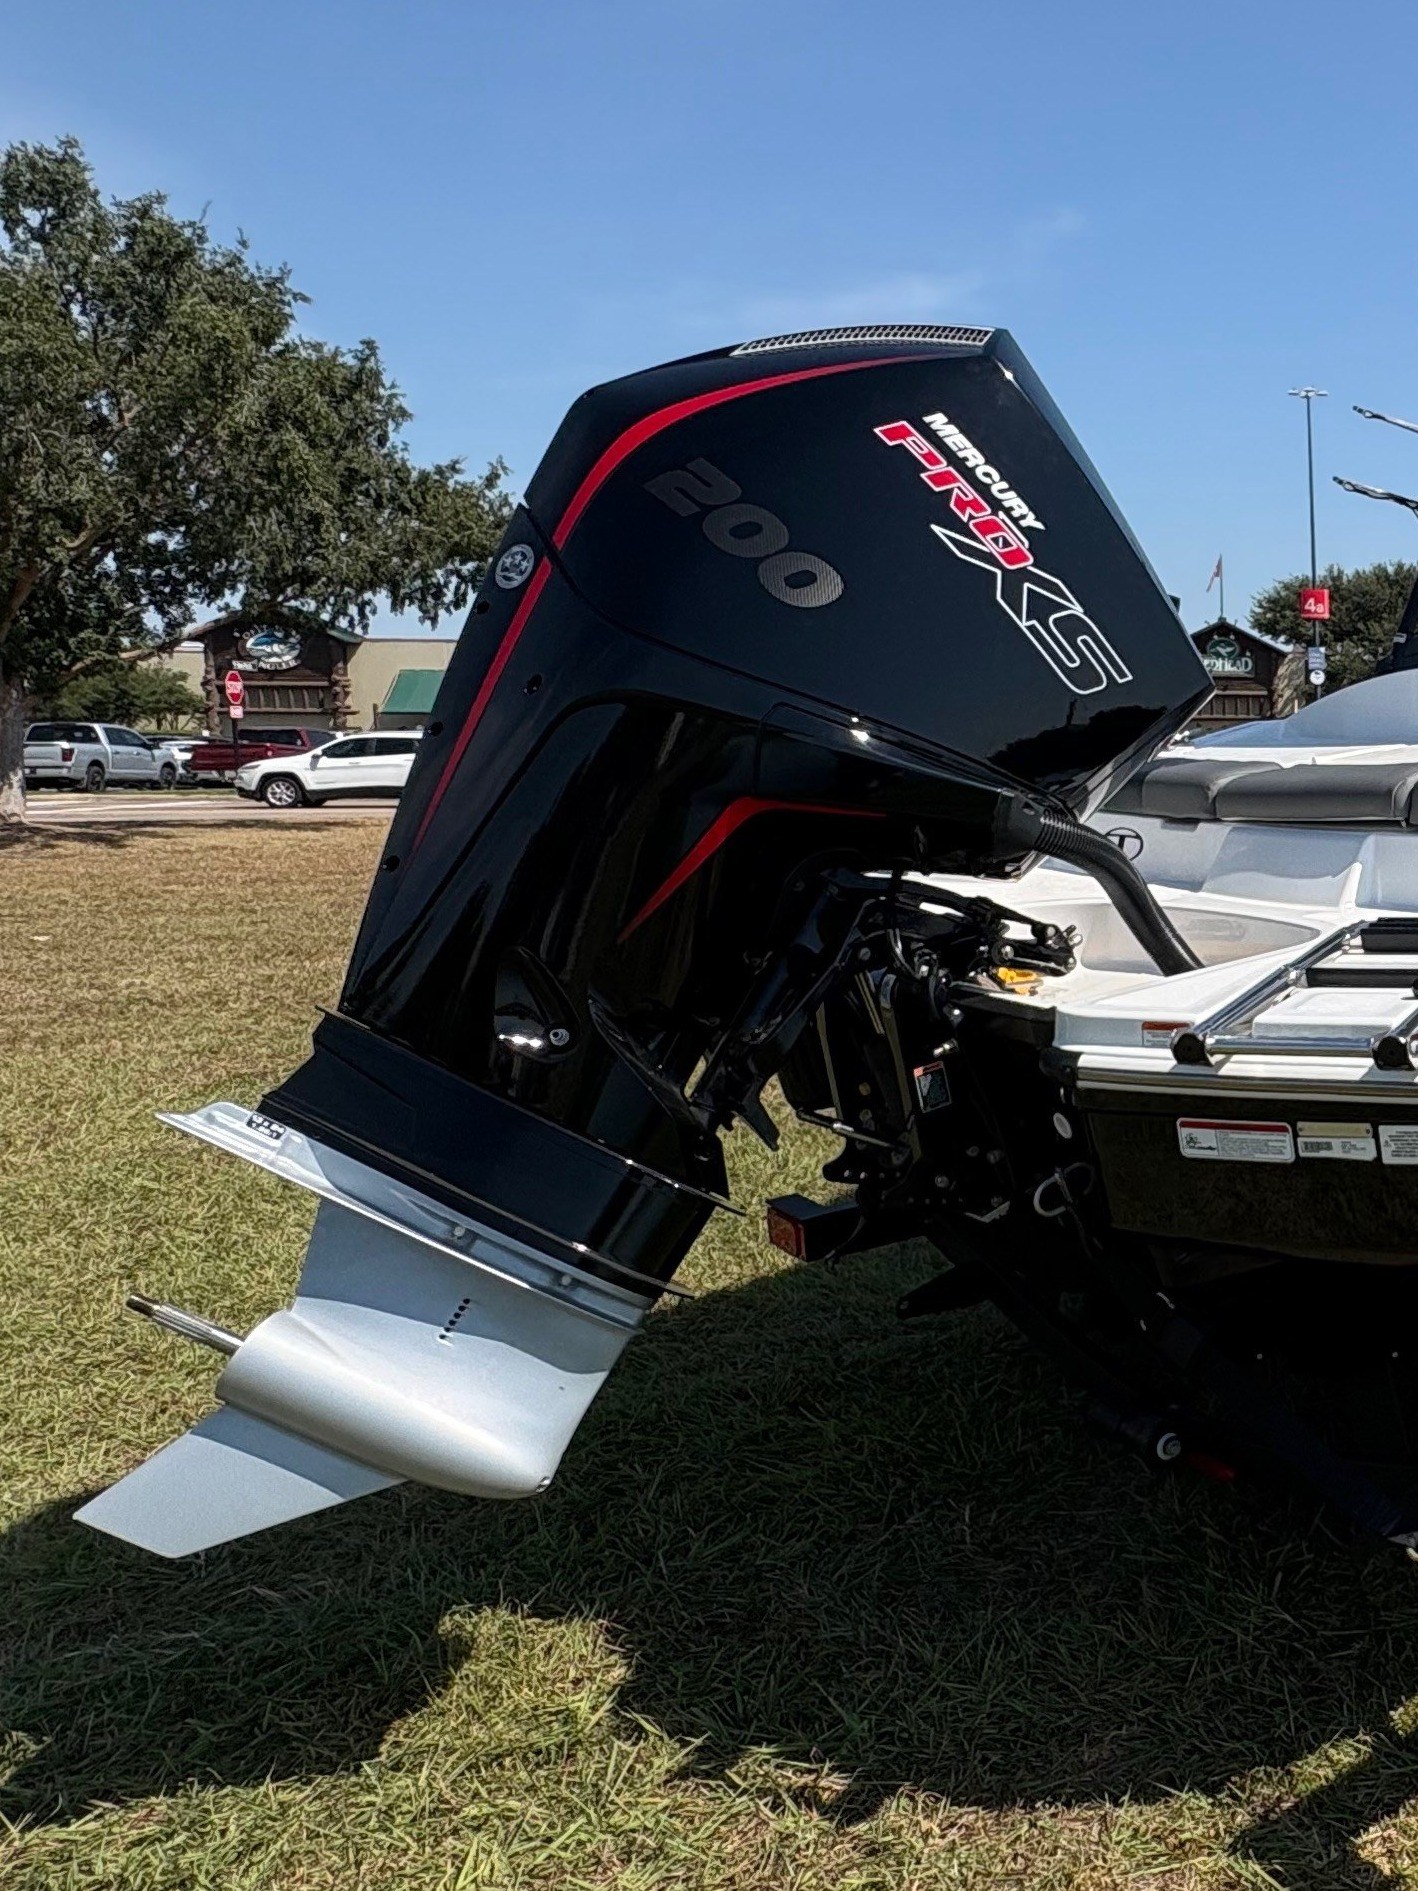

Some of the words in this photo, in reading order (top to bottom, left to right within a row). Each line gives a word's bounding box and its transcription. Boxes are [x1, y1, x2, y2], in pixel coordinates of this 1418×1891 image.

[642, 457, 846, 609] 200
[873, 420, 1035, 571] PRO
[923, 412, 1045, 532] MERCURY
[930, 523, 1133, 695] XS
[1303, 597, 1325, 614] 4a
